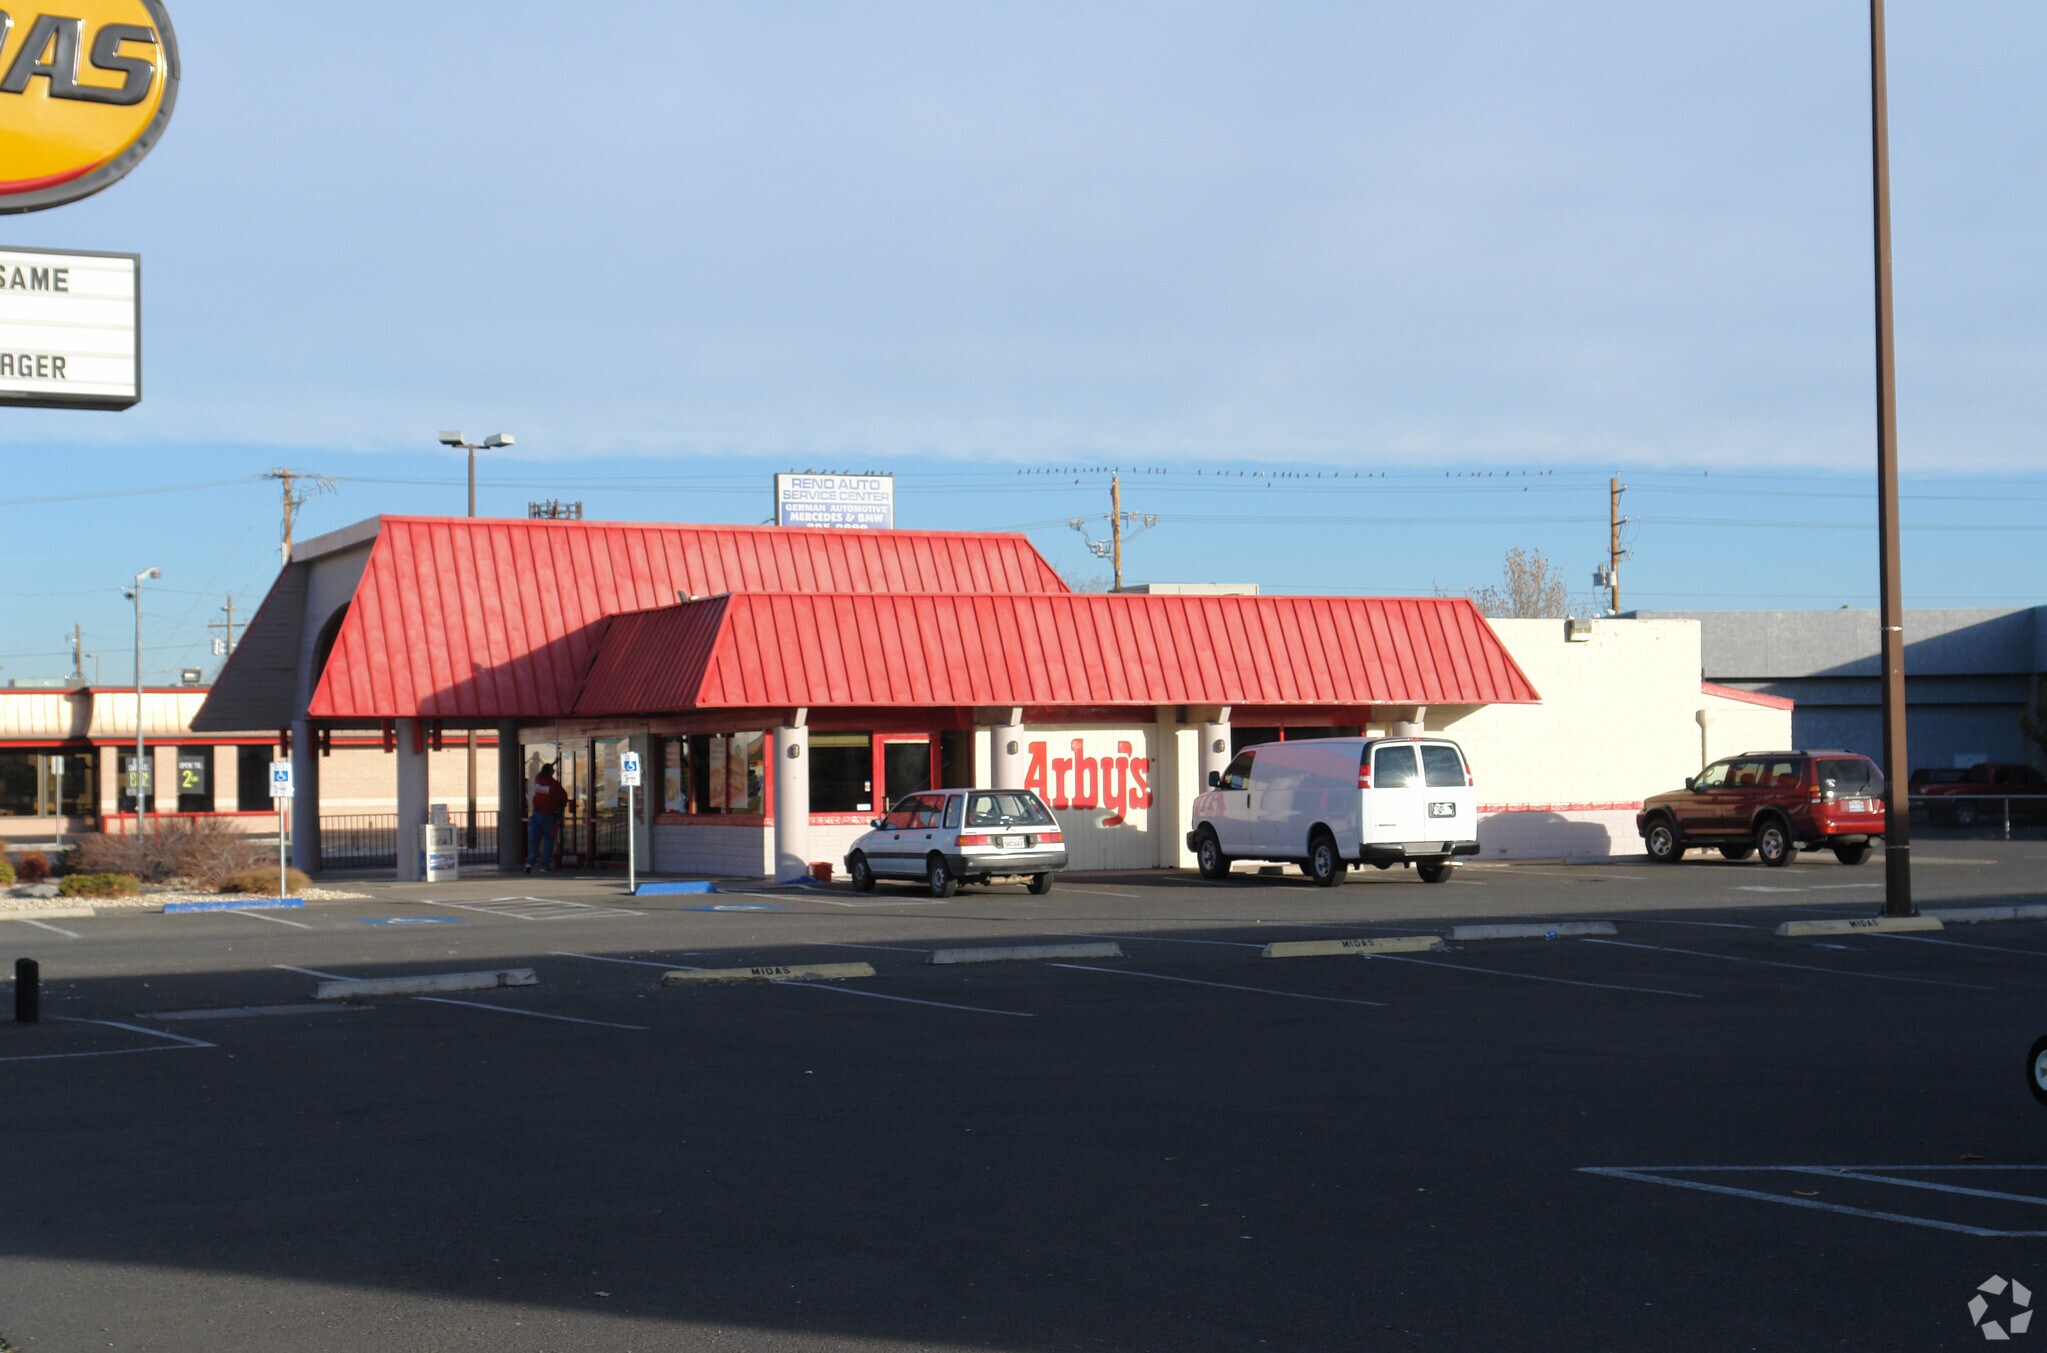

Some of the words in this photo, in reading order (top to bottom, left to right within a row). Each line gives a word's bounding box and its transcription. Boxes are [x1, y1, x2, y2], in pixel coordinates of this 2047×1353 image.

[792, 478, 835, 489] RENO
[838, 480, 880, 490] AUTO
[783, 490, 837, 500] SERVICE
[839, 491, 889, 501] CENTER
[785, 504, 826, 512] GERMAN
[830, 505, 888, 513] AUTOMOTIVE
[789, 512, 843, 522] MERCEDES
[845, 513, 855, 522] &
[857, 513, 884, 522] BMW
[1024, 738, 1153, 827] Arby's
[1341, 939, 1375, 948] MIDAS
[752, 966, 790, 975] MIDAS
